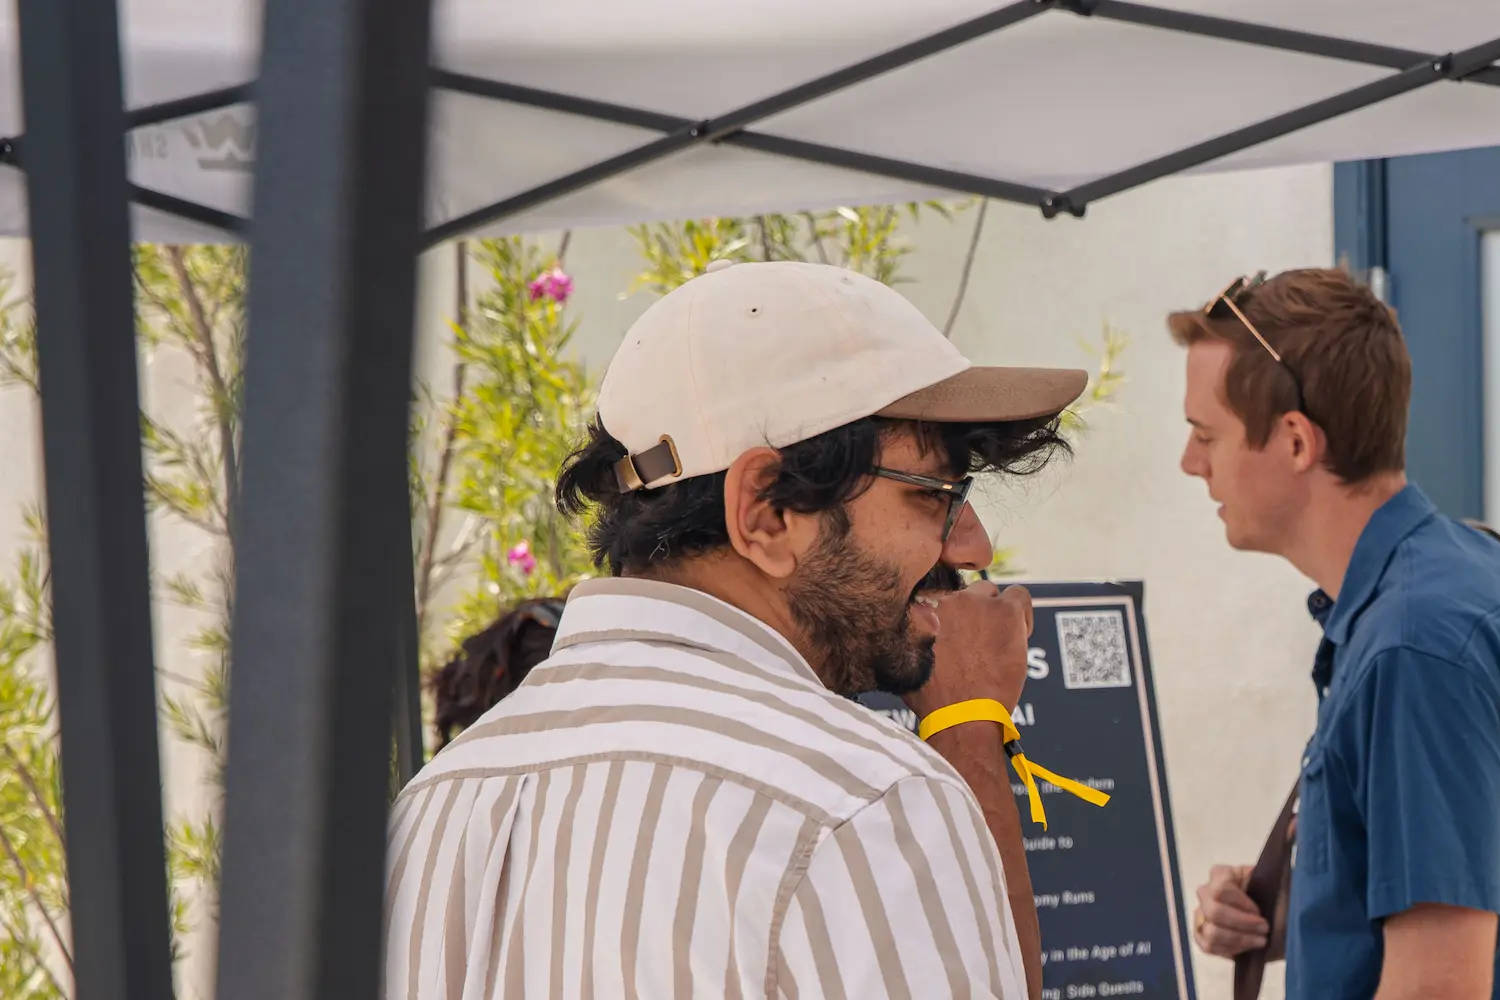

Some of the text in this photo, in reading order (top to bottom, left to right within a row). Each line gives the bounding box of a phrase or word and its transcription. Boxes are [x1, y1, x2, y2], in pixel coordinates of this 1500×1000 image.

[1058, 836, 1074, 850] to
[1062, 890, 1095, 904] Runs
[1050, 948, 1065, 961] in
[1066, 946, 1089, 961] the
[1091, 945, 1117, 961] Age
[1118, 942, 1134, 957] of
[1136, 941, 1151, 956] AI
[1067, 984, 1096, 999] Side
[1098, 981, 1144, 997] Quests
